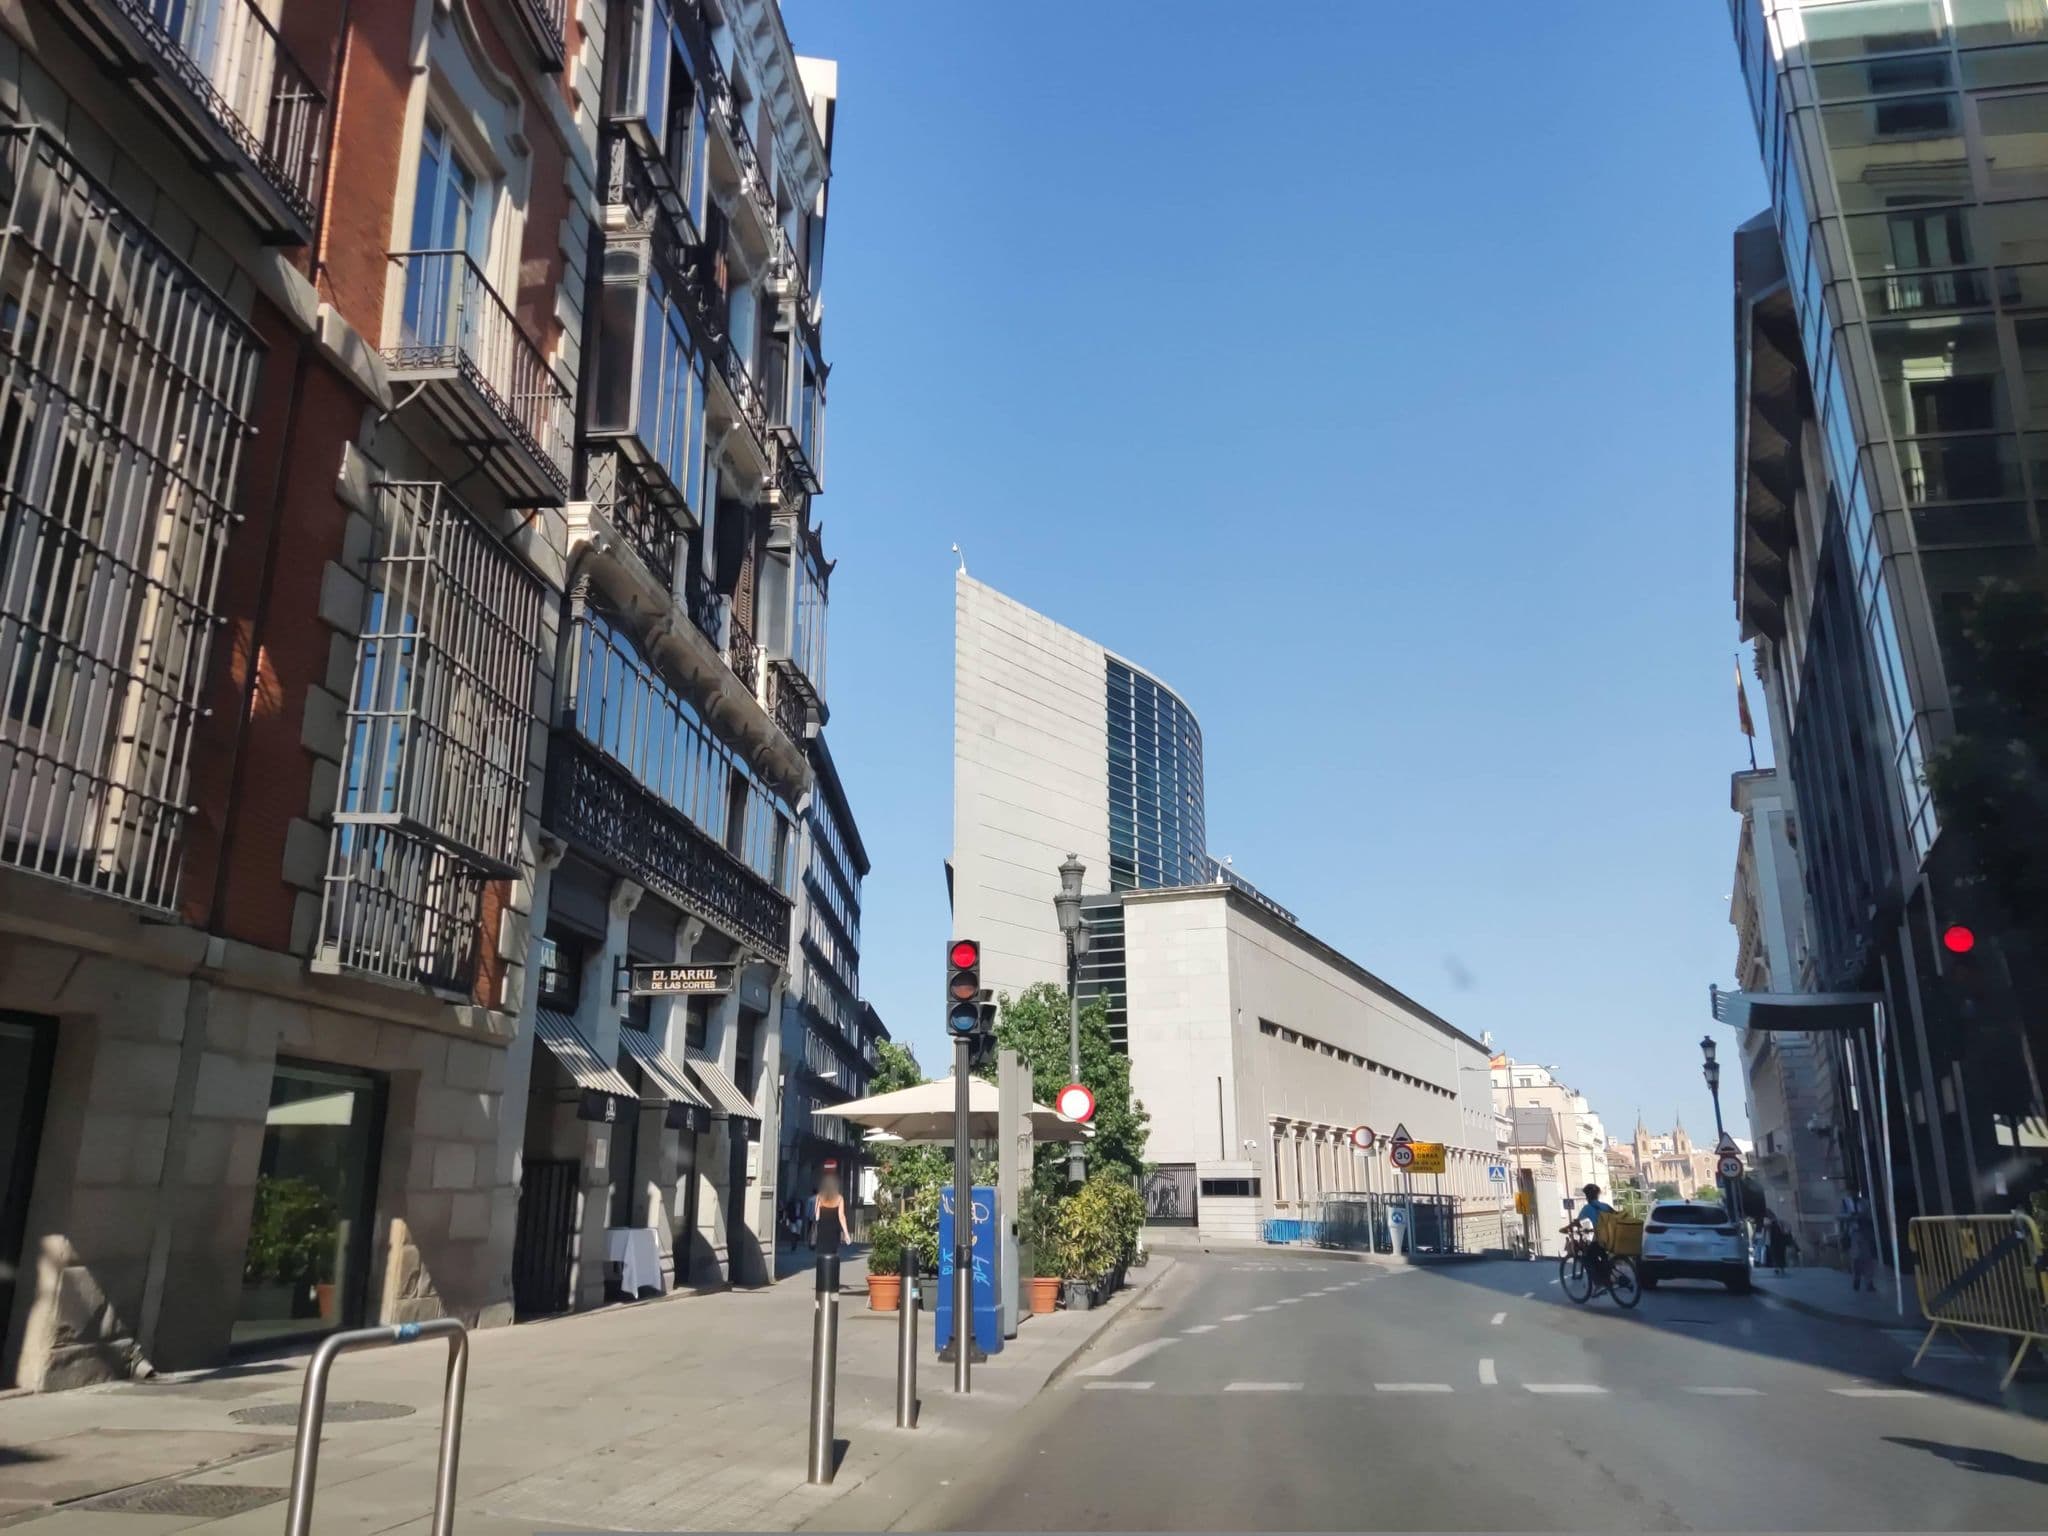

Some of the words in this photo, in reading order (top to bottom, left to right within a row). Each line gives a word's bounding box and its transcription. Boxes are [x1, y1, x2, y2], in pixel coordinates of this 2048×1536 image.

[653, 970, 668, 980] EL
[670, 970, 717, 980] BARRIL
[651, 981, 663, 990] DE
[664, 981, 681, 989] LAS
[682, 981, 716, 989] CORTES
[1397, 1152, 1410, 1160] 30
[1724, 1163, 1737, 1172] 30
